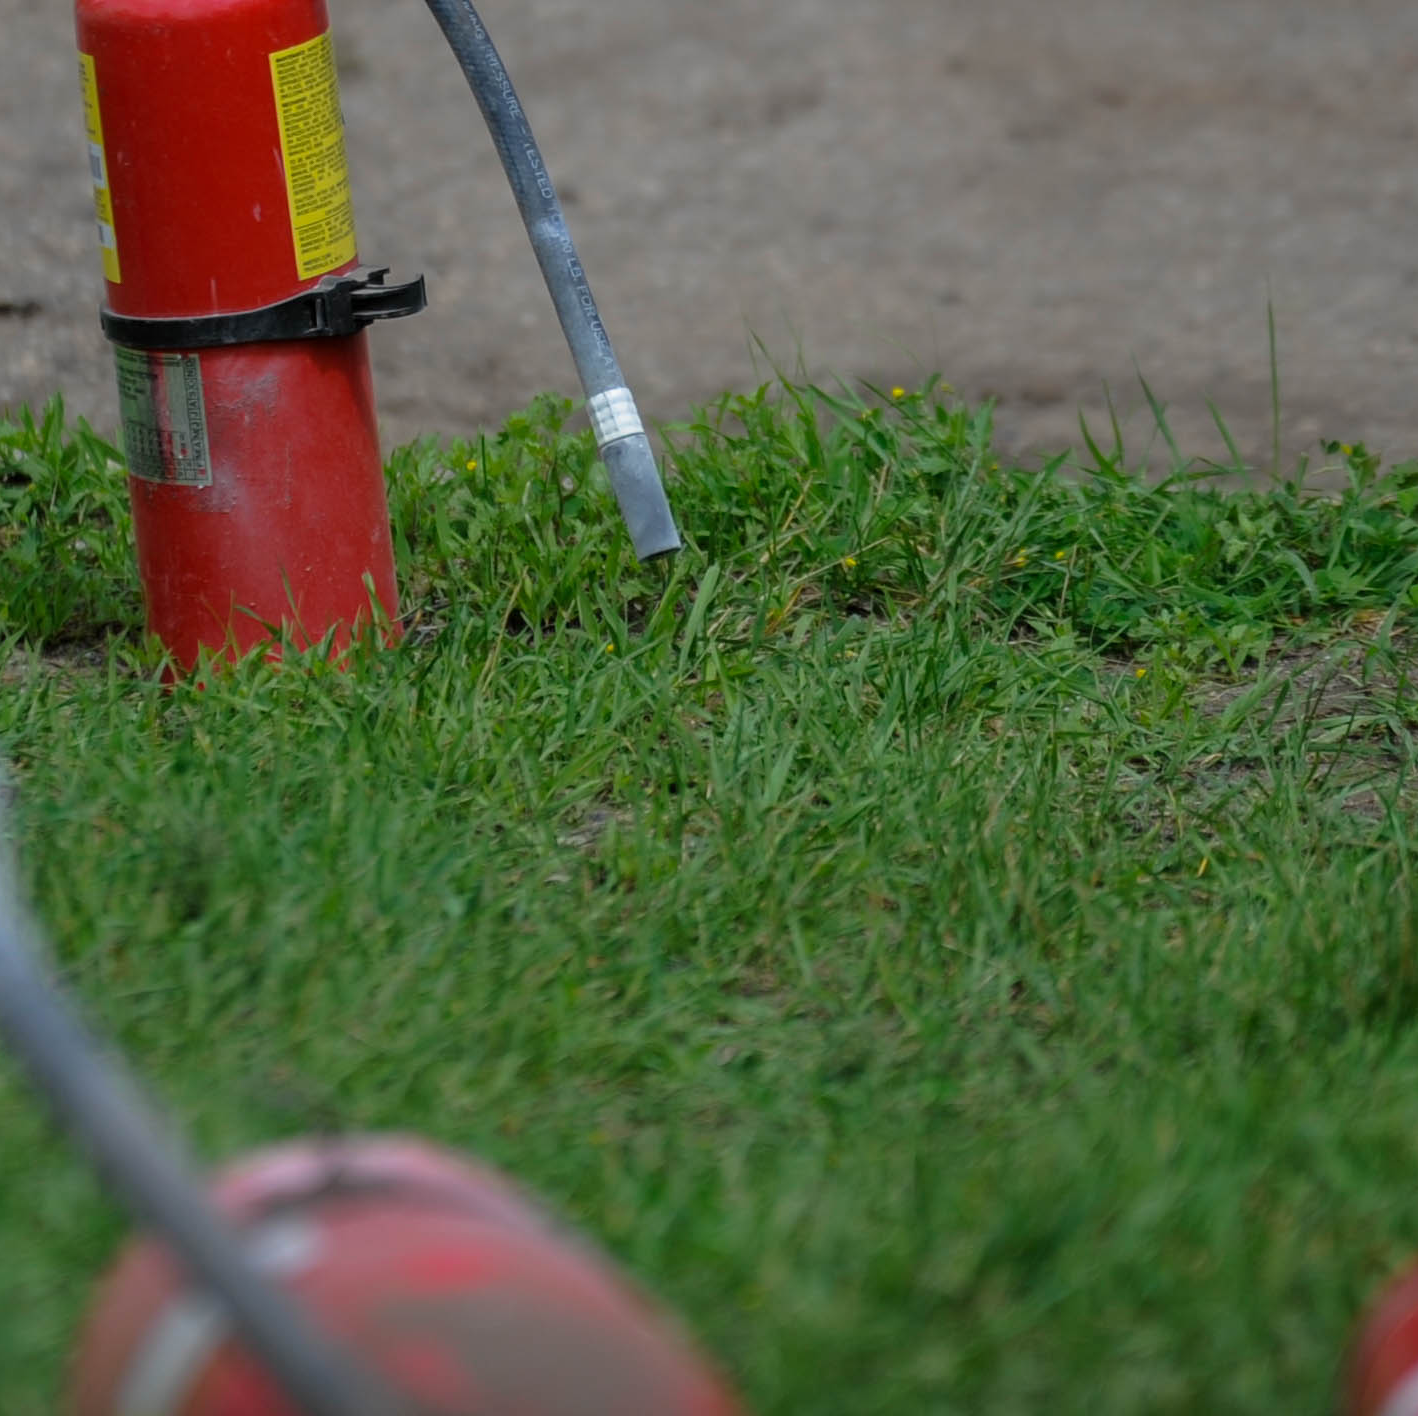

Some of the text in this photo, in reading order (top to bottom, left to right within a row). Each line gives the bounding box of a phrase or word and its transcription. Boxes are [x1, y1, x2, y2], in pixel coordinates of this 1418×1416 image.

[523, 139, 553, 199] TESTED
[576, 284, 595, 318] FOR
[589, 320, 608, 350] USE
